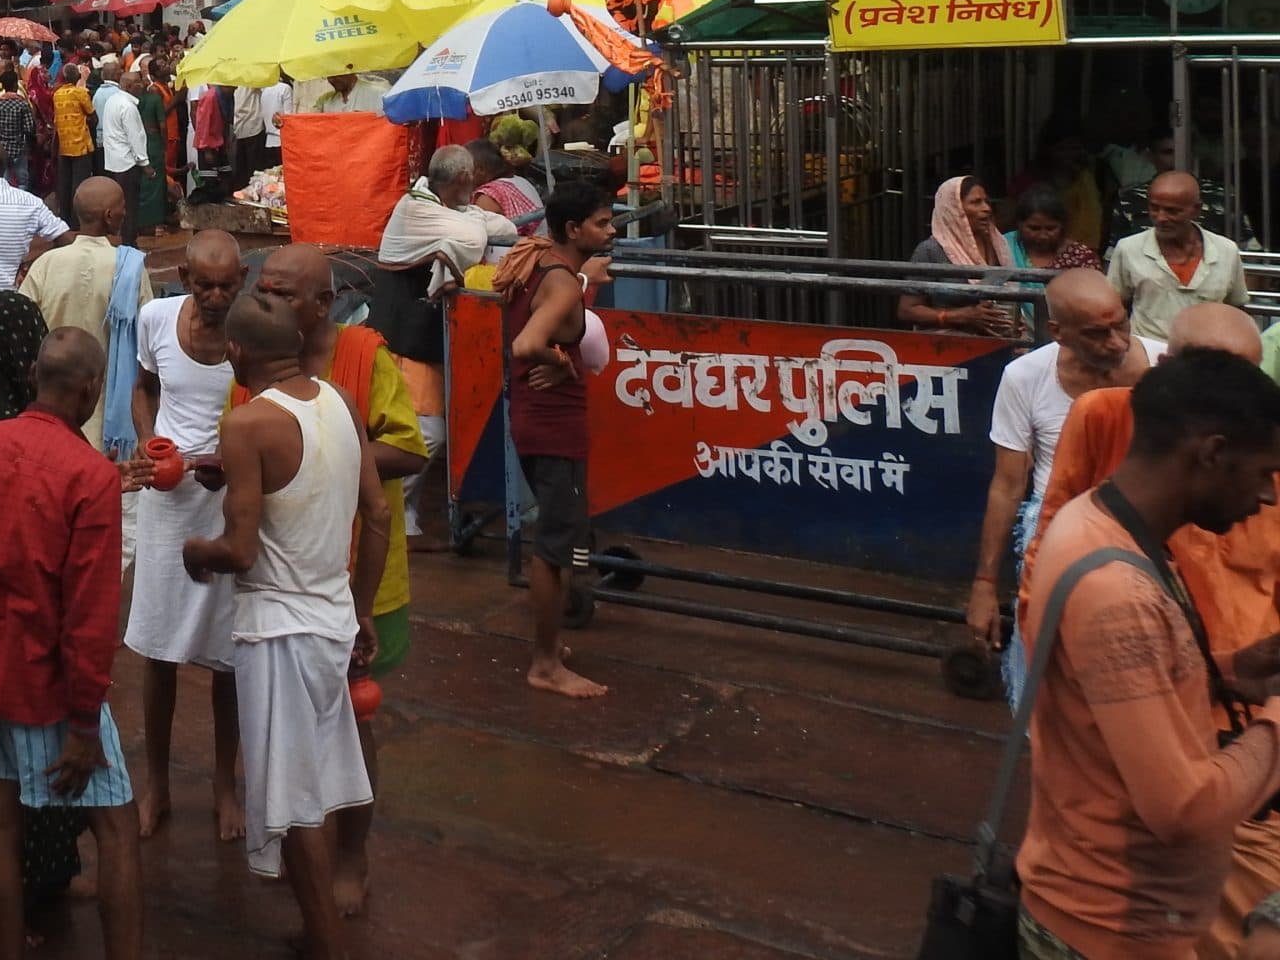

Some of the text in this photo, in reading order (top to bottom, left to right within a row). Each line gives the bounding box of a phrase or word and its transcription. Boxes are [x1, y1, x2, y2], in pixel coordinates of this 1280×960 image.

[323, 14, 364, 28] LALL
[314, 25, 378, 42] STEELS
[497, 86, 576, 110] 95340 95340
[774, 339, 969, 447] पुलिस
[694, 440, 911, 495] आपकी सेवा में
